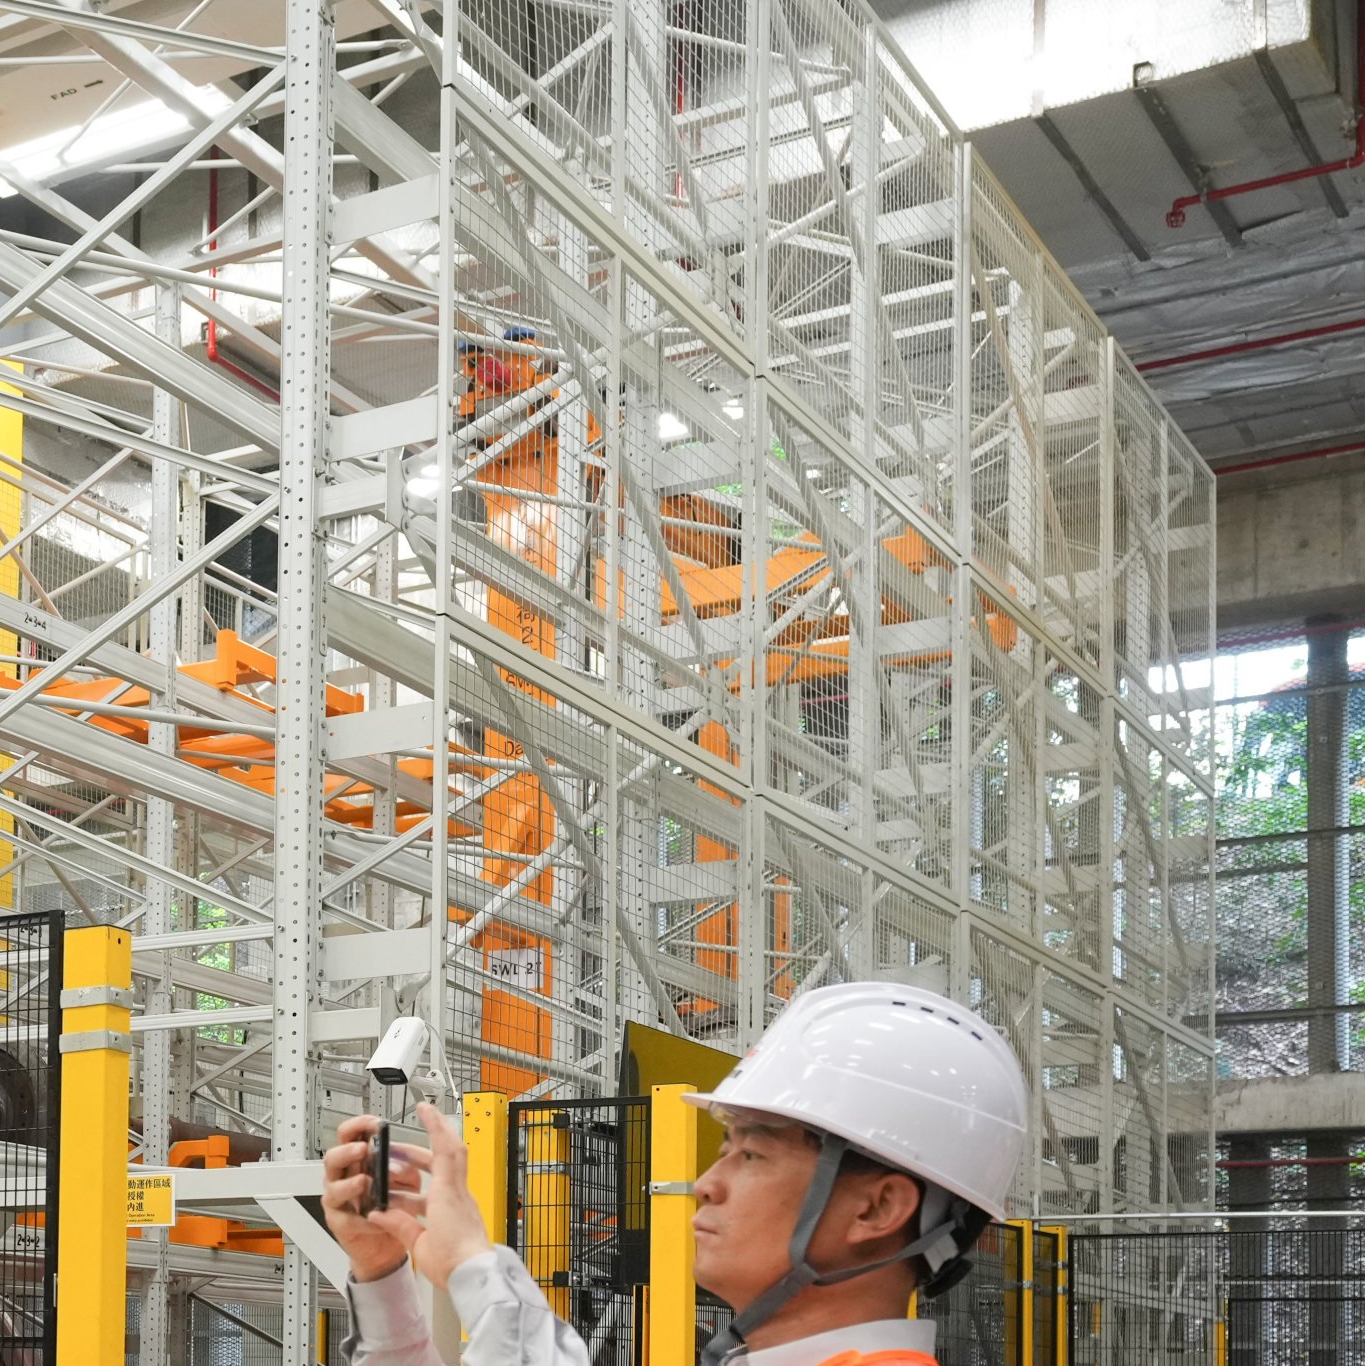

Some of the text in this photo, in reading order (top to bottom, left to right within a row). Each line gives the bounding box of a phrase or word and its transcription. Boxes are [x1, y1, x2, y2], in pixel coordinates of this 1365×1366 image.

[24, 612, 47, 630] 2-3-4
[127, 1178, 171, 1190] 動運作區域
[127, 1190, 144, 1201] 授權
[17, 1233, 40, 1247] 2-3-2
